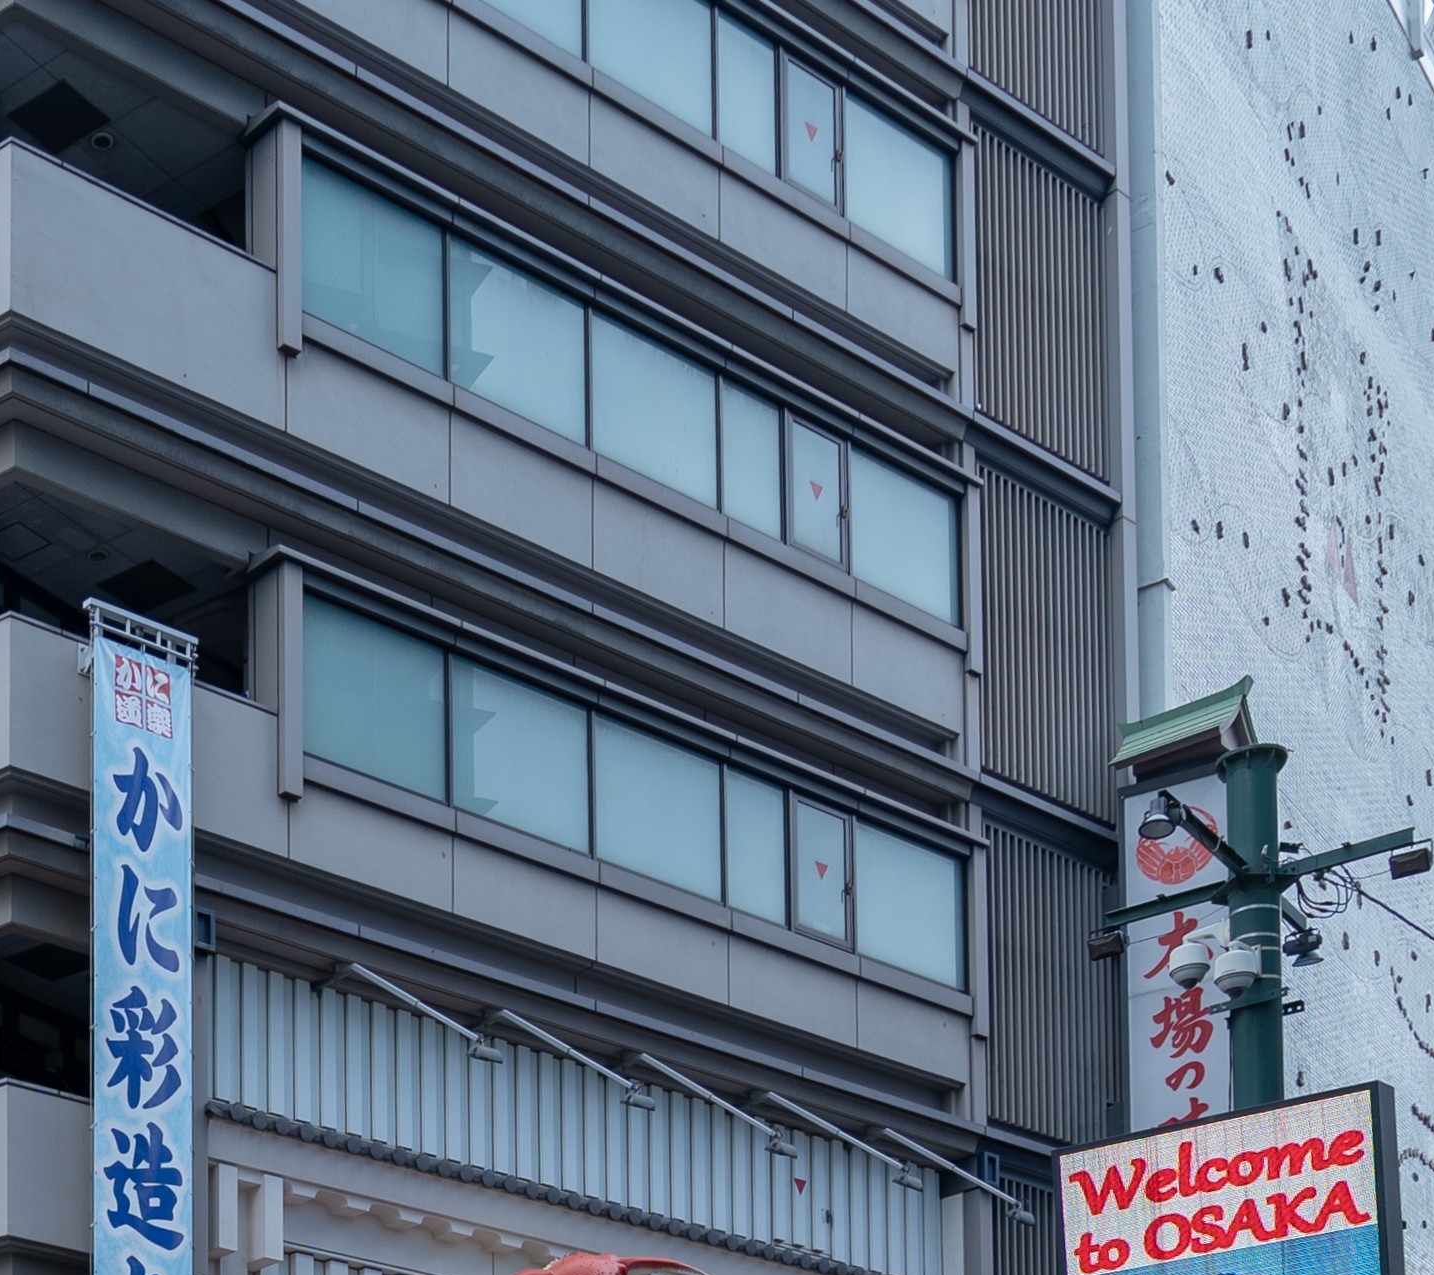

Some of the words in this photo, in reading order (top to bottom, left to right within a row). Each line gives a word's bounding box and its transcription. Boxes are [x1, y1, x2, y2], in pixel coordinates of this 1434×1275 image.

[1069, 1129, 1365, 1217] Welcome
[1074, 1232, 1130, 1275] to
[1143, 1181, 1372, 1262] OSAKA
